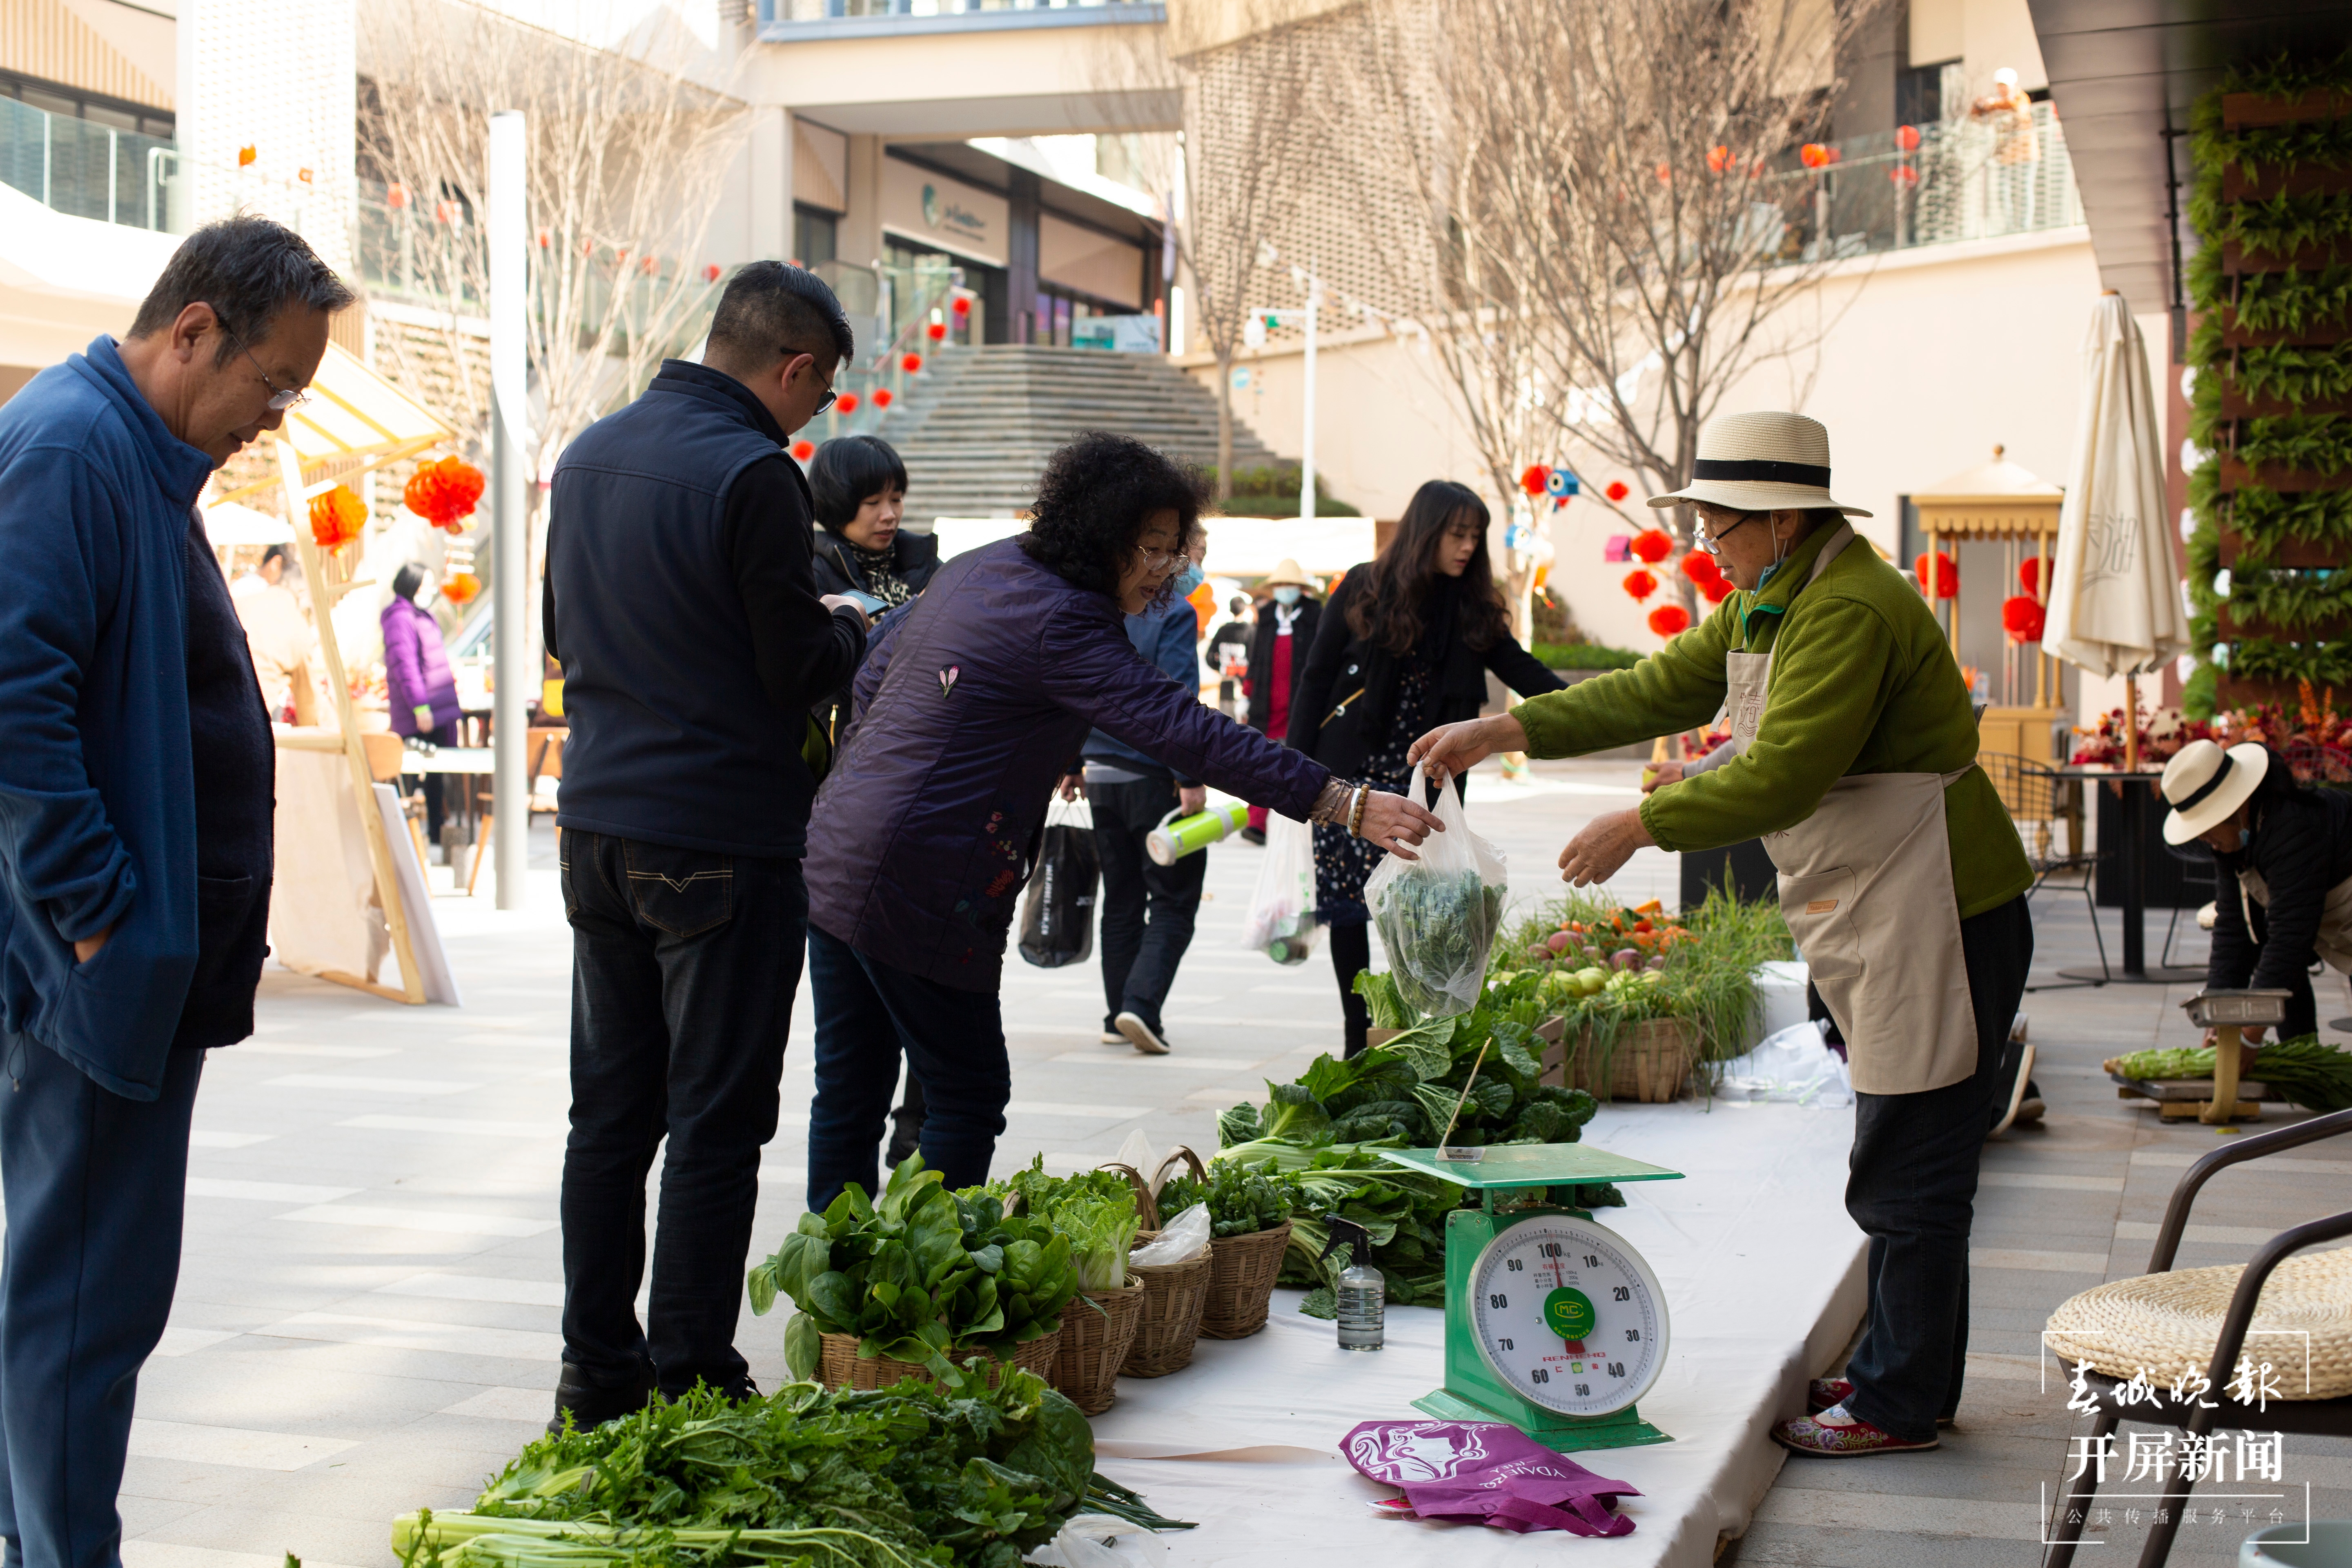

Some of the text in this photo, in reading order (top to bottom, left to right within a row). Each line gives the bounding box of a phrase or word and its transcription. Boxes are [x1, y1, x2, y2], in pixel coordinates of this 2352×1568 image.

[1508, 1259, 1523, 1271] 90
[1613, 1286, 1630, 1301] 20
[1490, 1294, 1508, 1309] 80
[1559, 1305, 1579, 1314] MC
[1626, 1330, 1639, 1341] 30
[1499, 1339, 1513, 1351] 70
[1555, 1365, 1563, 1373] 仁
[1608, 1363, 1625, 1378] 40
[1532, 1369, 1549, 1383] 60
[1575, 1384, 1590, 1396] 50
